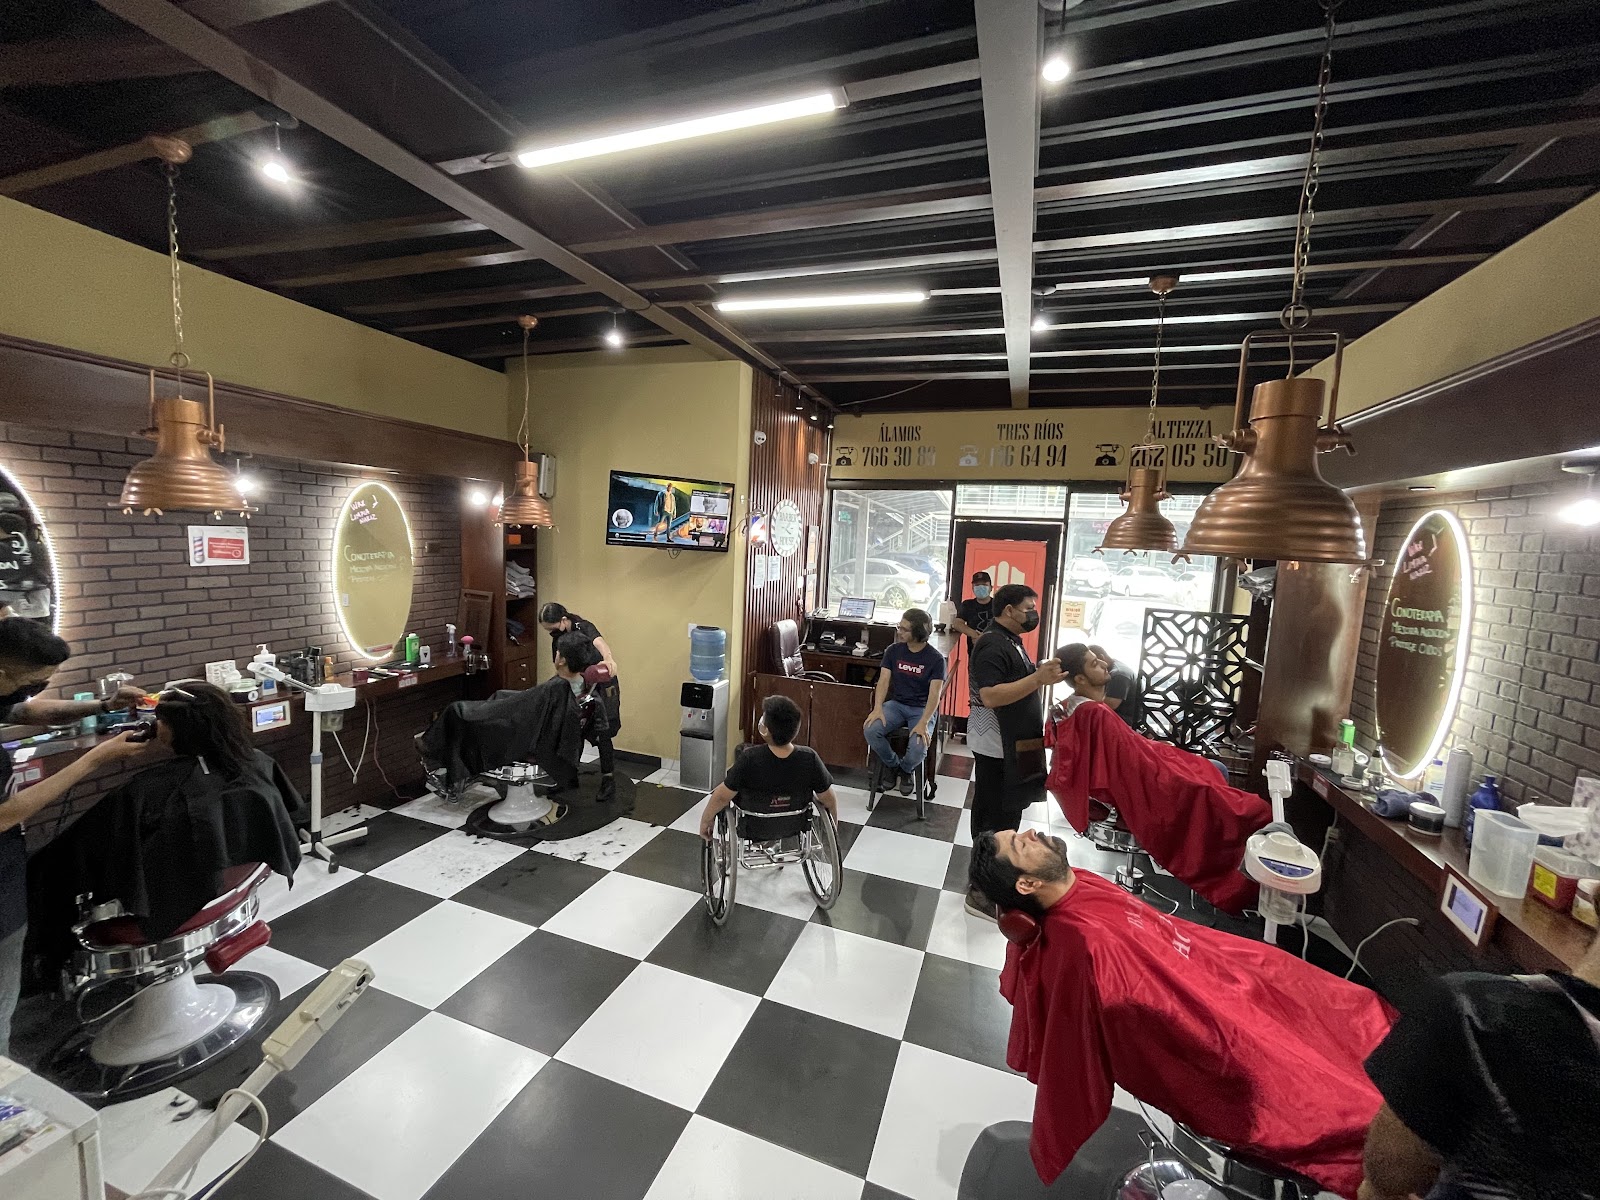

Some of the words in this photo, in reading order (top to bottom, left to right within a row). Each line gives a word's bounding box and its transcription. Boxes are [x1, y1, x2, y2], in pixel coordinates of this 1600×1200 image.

[878, 423, 922, 443] ÁLAMOS
[997, 423, 1030, 442] TRES
[1034, 419, 1064, 440] RÍOS
[862, 446, 889, 467] 766
[893, 446, 912, 467] 30
[1019, 445, 1041, 467] 64
[1046, 444, 1068, 467] 94
[1171, 444, 1196, 467] 05
[1202, 444, 1229, 467] 50
